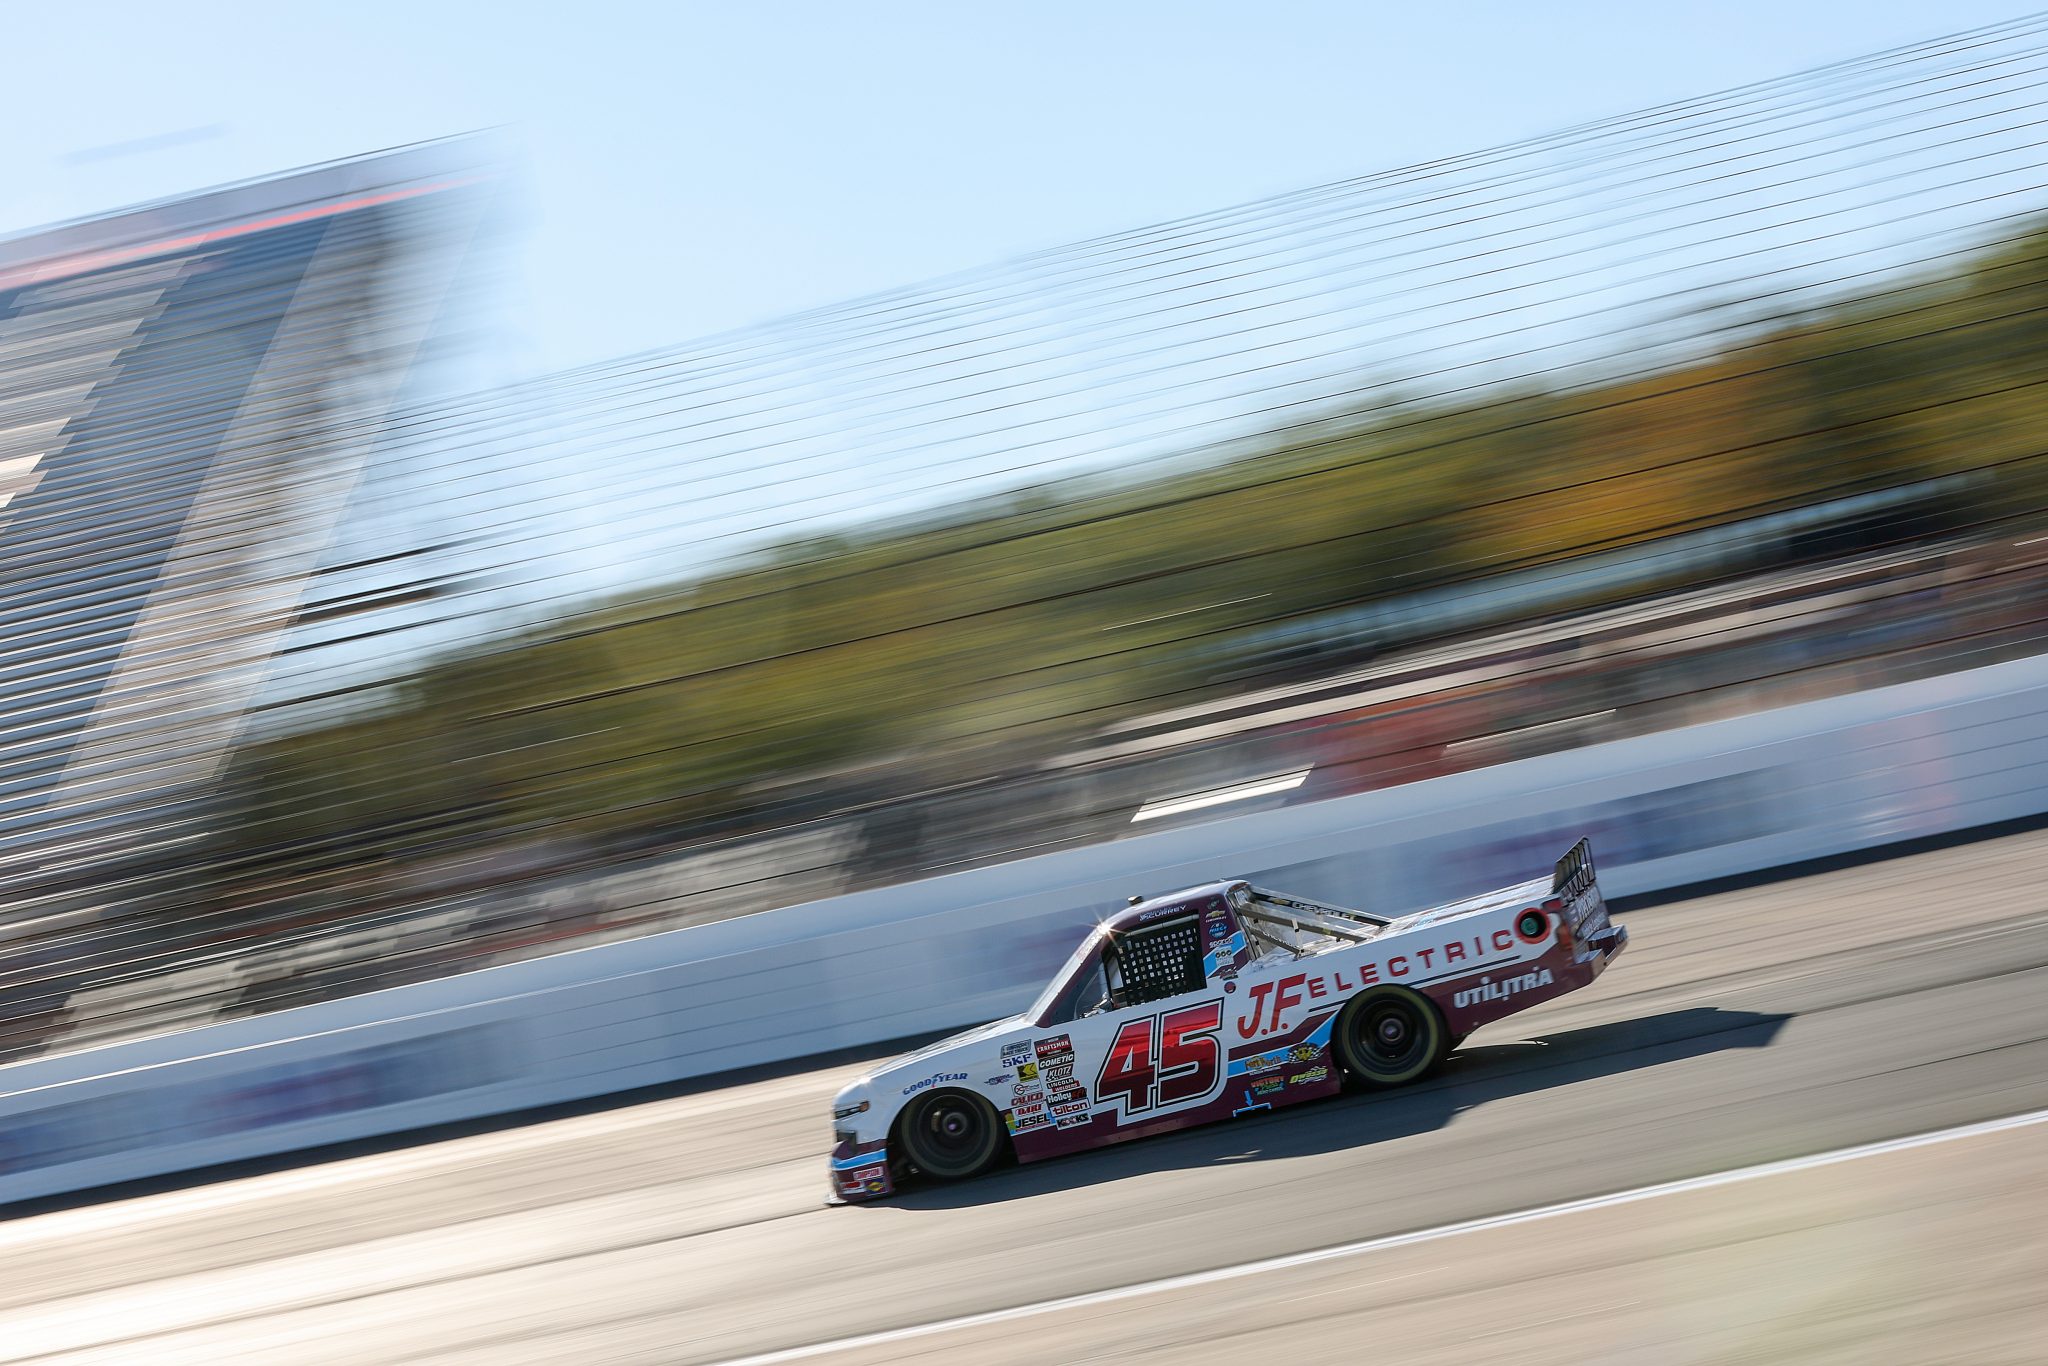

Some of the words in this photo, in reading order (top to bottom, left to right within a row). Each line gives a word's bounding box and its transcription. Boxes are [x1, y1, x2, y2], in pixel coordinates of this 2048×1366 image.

[1307, 929, 1514, 999] ELECTRIC
[1037, 1040, 1069, 1053] CRAFTSMAN
[1002, 1053, 1032, 1068] SKF
[1094, 997, 1225, 1117] 45
[1048, 1065, 1072, 1077] KLOTZ
[903, 1073, 968, 1095] GOODYEAR
[1047, 1078, 1074, 1089] LINCOLN
[1055, 1082, 1078, 1092] WELDERS
[1047, 1092, 1072, 1104] Holley
[1053, 1102, 1088, 1116] tilton
[1016, 1112, 1051, 1129] JESEL
